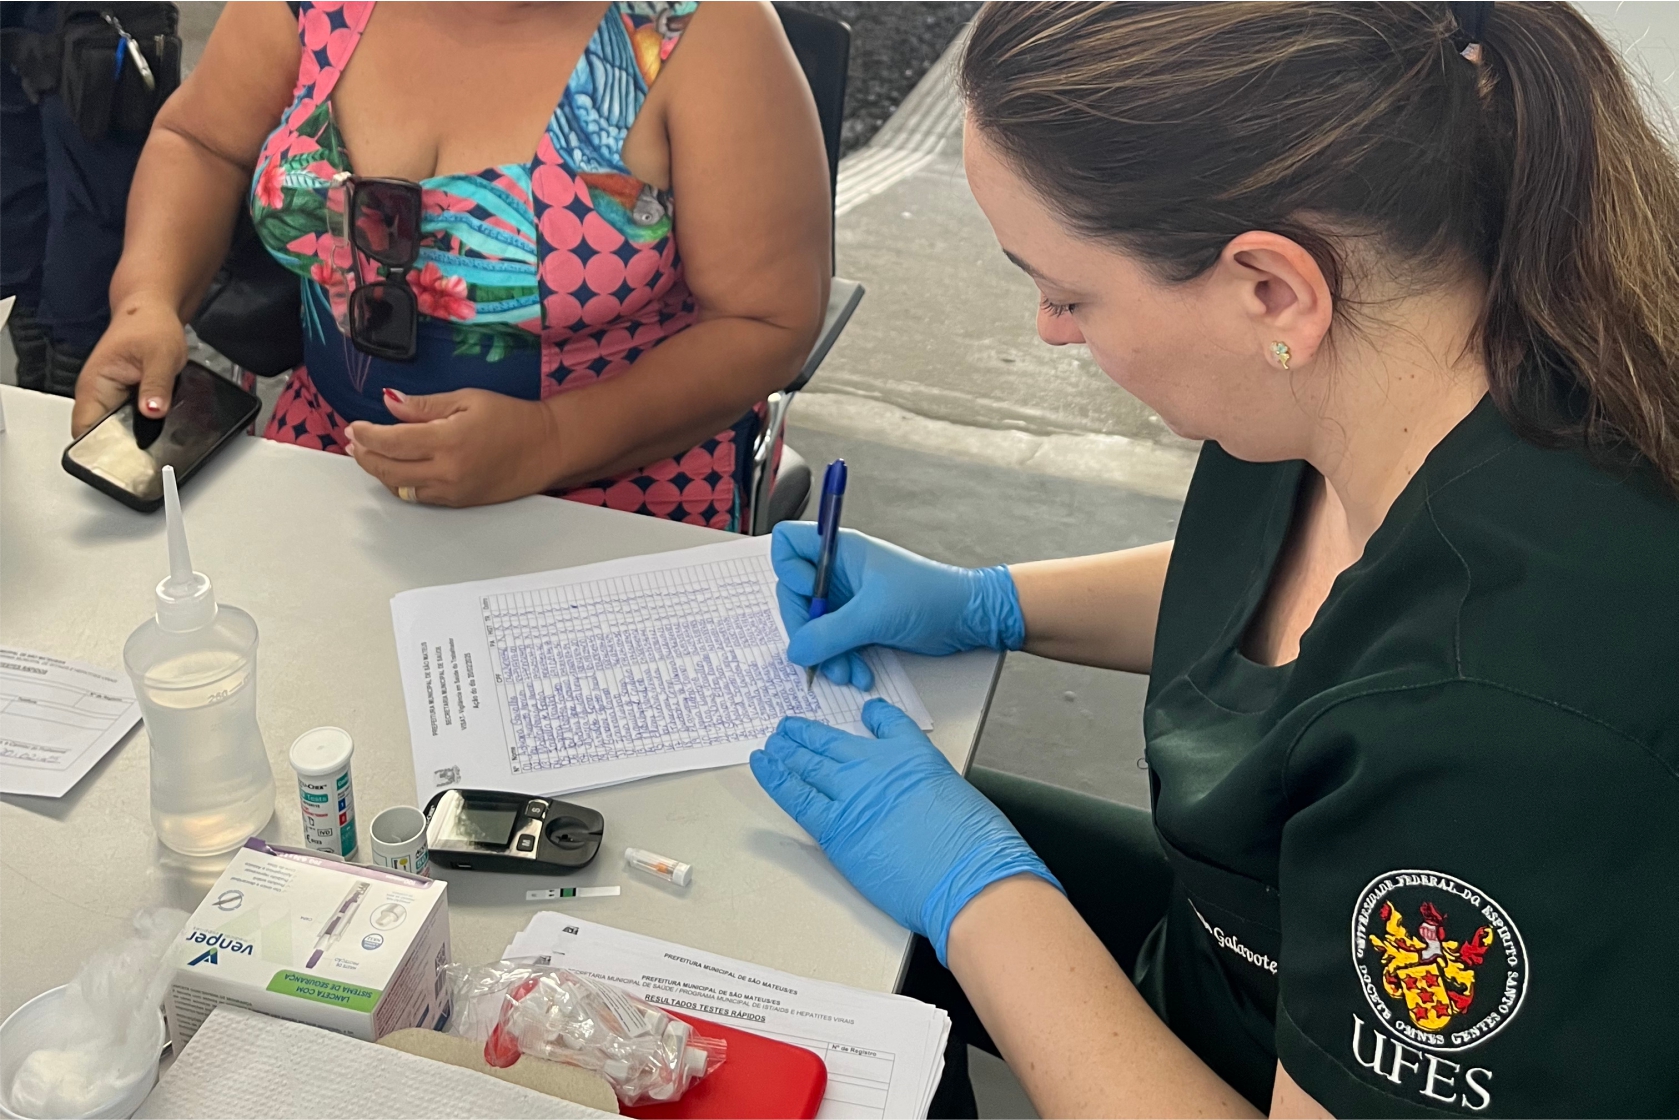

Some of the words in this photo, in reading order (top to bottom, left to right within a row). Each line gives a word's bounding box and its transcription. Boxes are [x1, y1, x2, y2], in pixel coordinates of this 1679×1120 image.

[495, 673, 503, 683] CPF
[185, 931, 253, 956] venper
[1355, 878, 1394, 959] UNIVERSIDADE
[1396, 874, 1458, 894] FEDERAL
[1463, 888, 1481, 907] DO
[1498, 970, 1519, 1014] SANTO
[284, 973, 329, 989] SEGURANÇA
[330, 983, 340, 991] DE
[664, 953, 702, 968] PREFEITURA
[703, 964, 736, 979] MUNICIPAL
[747, 975, 761, 985] SÃO
[762, 981, 798, 996] MATEUS/ES
[296, 986, 315, 995] COM
[317, 990, 350, 1003] LANCETA
[343, 987, 373, 998] SISTEMA
[607, 975, 640, 987] MUNICIPAL
[642, 980, 650, 988] DE
[652, 981, 674, 993] SAÚDE
[679, 988, 715, 1001] PROGRAMA
[716, 994, 750, 1007] MUNICIPAL
[752, 1001, 761, 1009] DE
[796, 1010, 832, 1021] HEPATITES
[833, 1016, 855, 1025] VIRAIS
[641, 975, 681, 987] PREFEITURA
[683, 982, 716, 994] MUNICIPAL
[718, 988, 727, 996] DE
[728, 990, 742, 999] SÃO
[743, 993, 781, 1006] MATEUS/ES
[645, 993, 696, 1010] RESULTADOS
[700, 1003, 729, 1016] TESTES
[731, 1009, 766, 1024] RÁPIDOS
[1395, 1020, 1445, 1045] OMNES
[1451, 1011, 1502, 1045] GENTES
[841, 1044, 849, 1052] de
[850, 1047, 877, 1057] Registro
[1352, 1012, 1494, 1112] UFES
